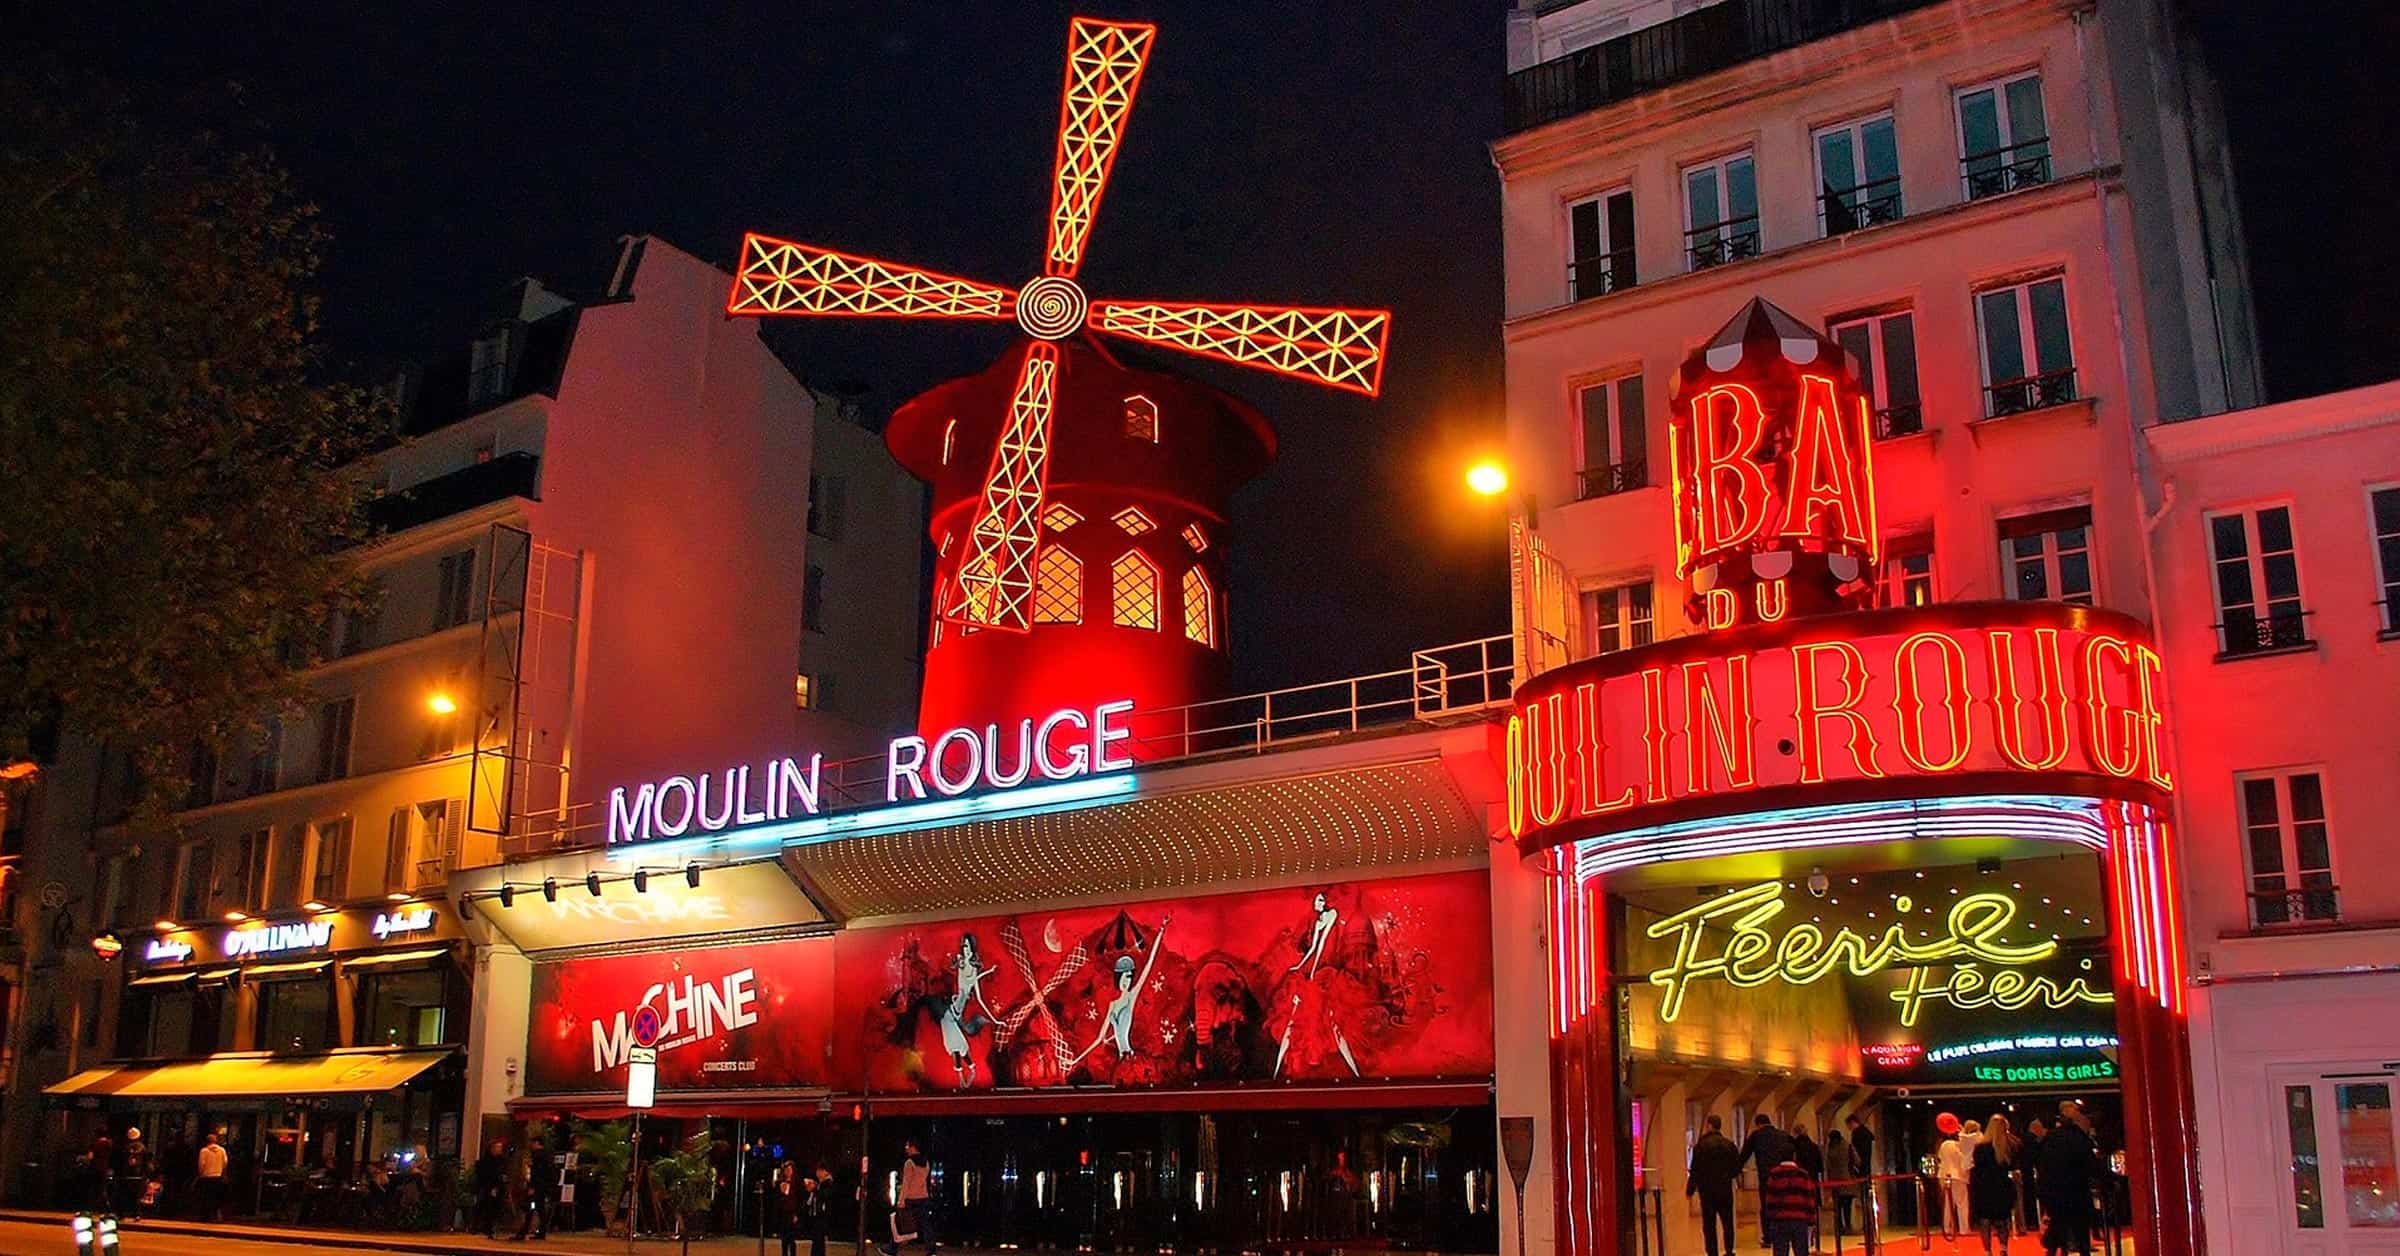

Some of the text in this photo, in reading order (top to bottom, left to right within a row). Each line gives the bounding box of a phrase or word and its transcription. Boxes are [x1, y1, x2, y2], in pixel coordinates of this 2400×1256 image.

[1690, 374, 1878, 566] BA
[1707, 579, 1787, 630] DU
[606, 699, 1136, 843] MOULIN ROUGE
[1507, 627, 2174, 840] OULIN ROUGE
[1975, 1062, 2113, 1081] LES DORISS GIRLS
